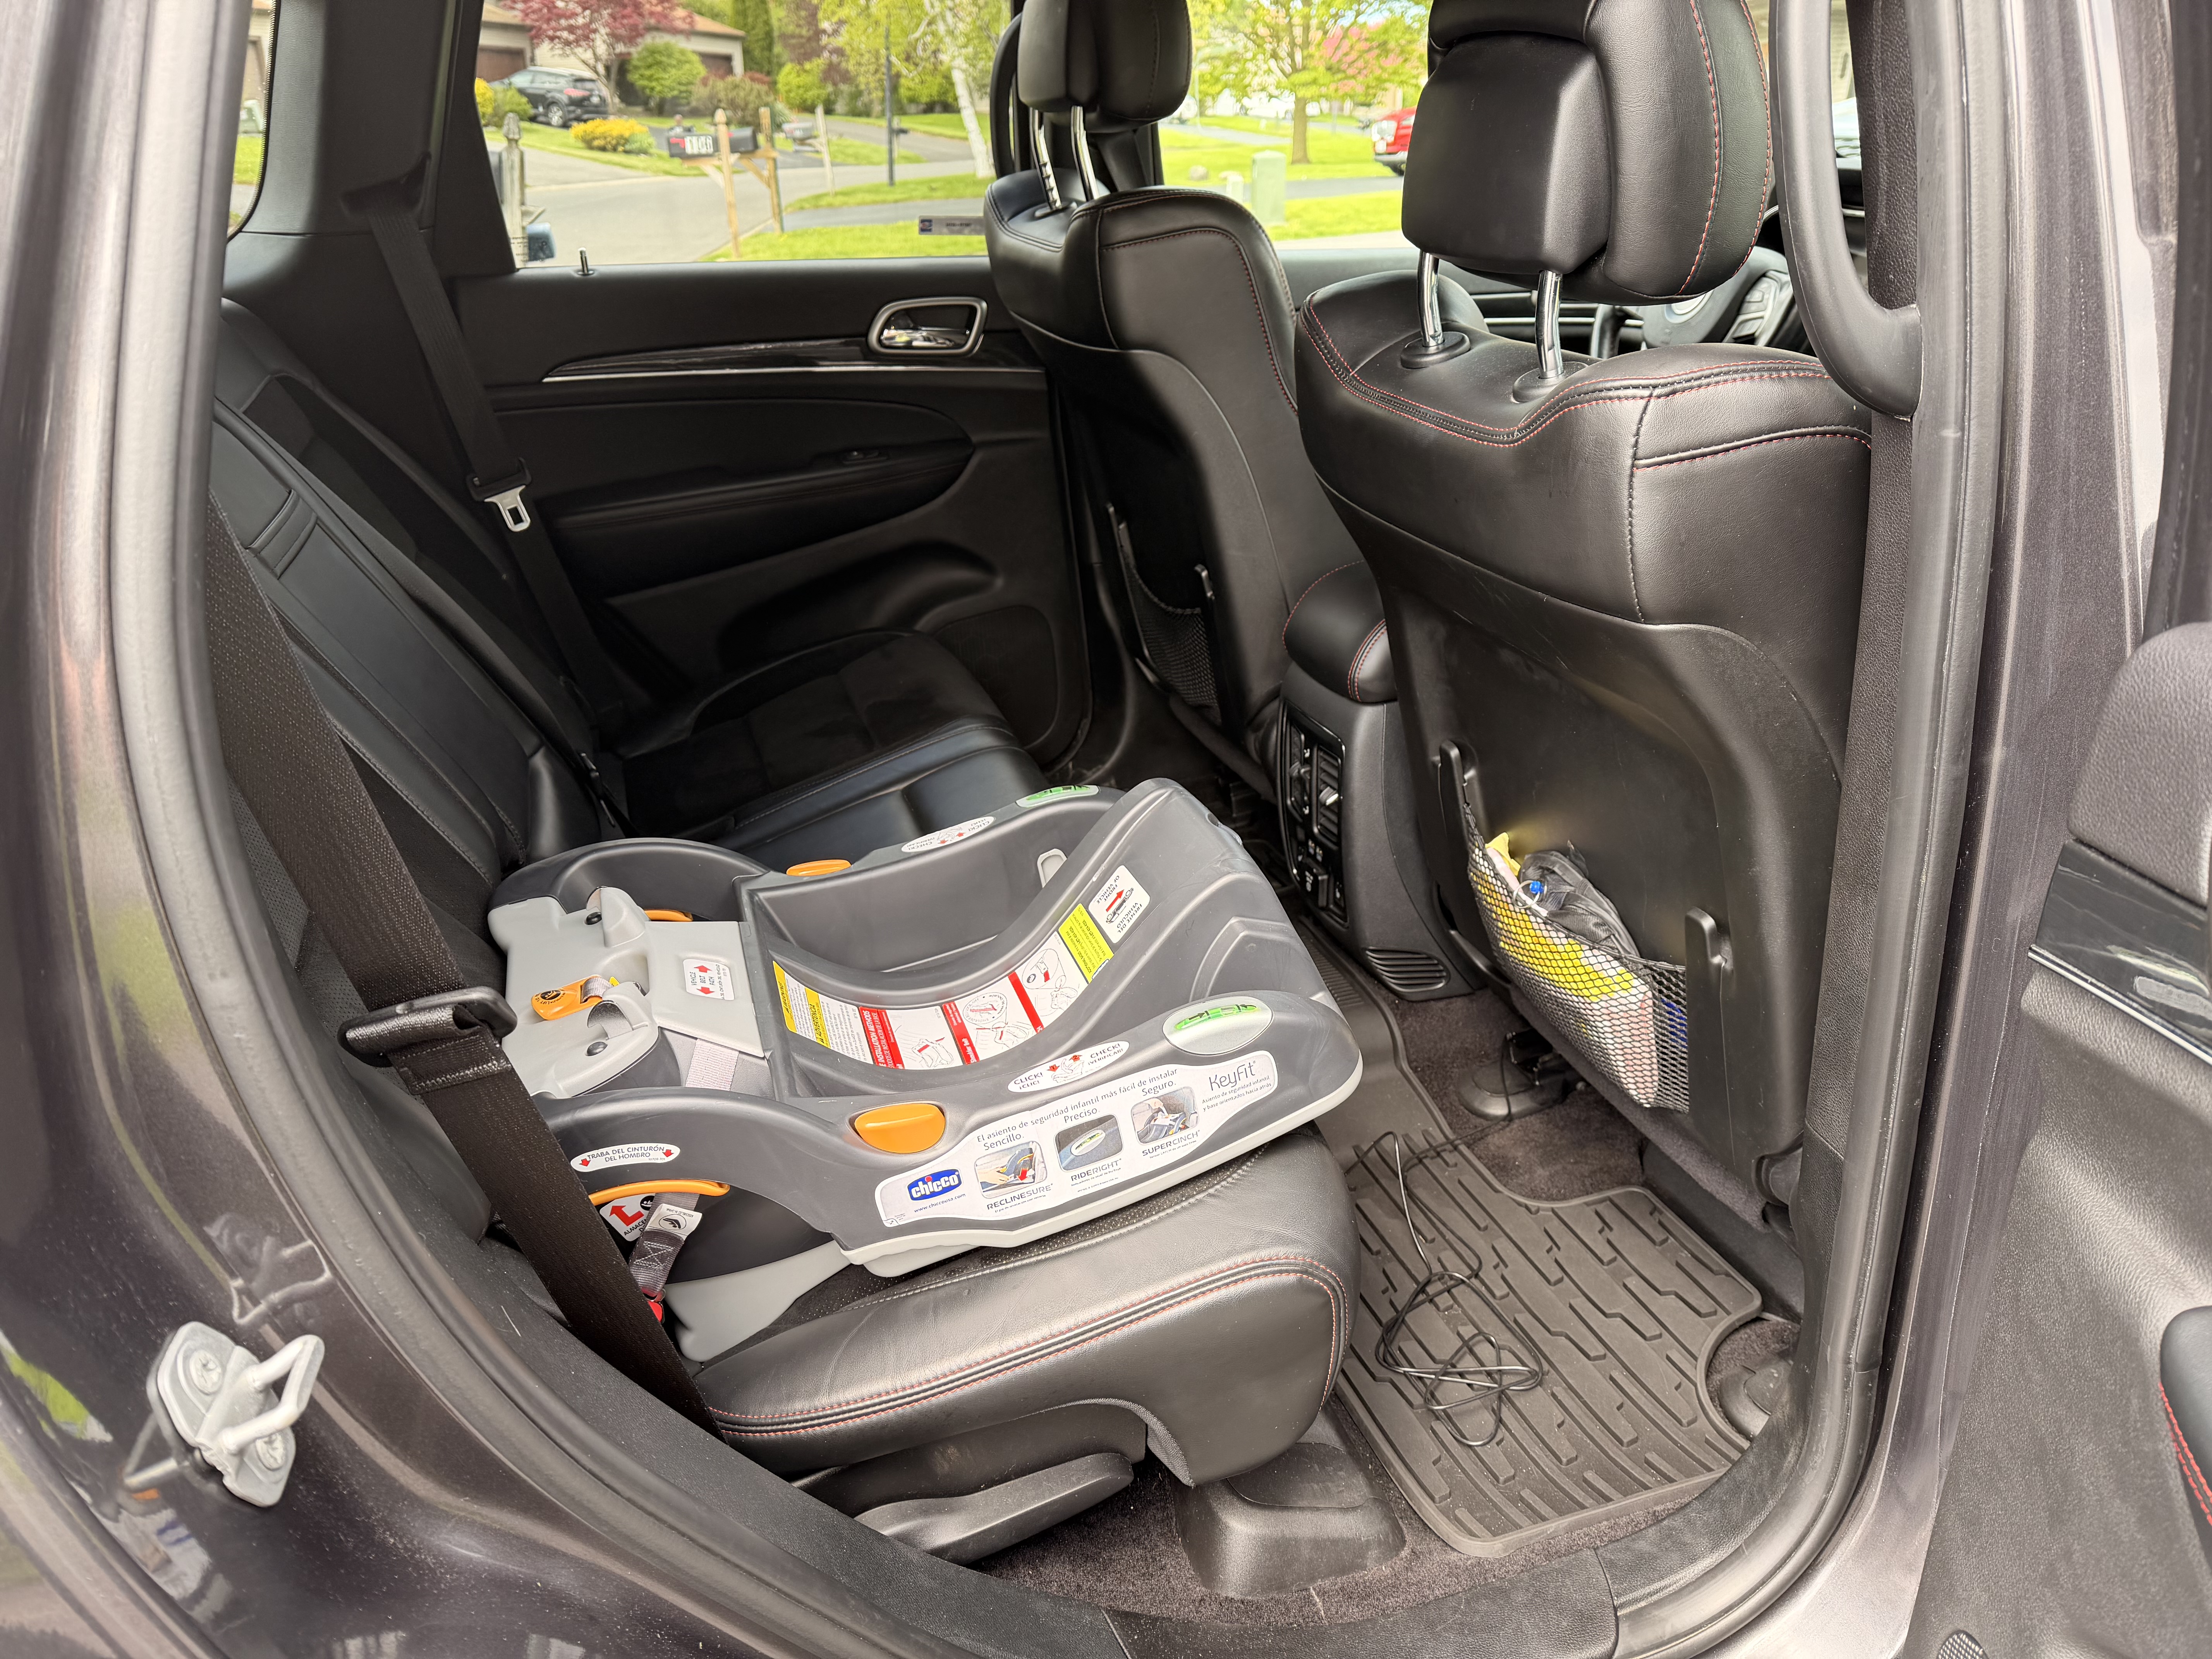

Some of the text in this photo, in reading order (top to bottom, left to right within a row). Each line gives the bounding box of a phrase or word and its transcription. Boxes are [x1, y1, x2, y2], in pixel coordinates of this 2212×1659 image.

[1097, 884, 1113, 904] VEHICLE
[1104, 884, 1118, 902] FRONT
[1118, 904, 1142, 933] FRENTE DEL
[863, 1010, 875, 1031] METHODS
[869, 1032, 885, 1062] INSTALLATION
[1091, 1043, 1121, 1058] CHECK!
[1014, 1072, 1043, 1084] CLICK!
[1142, 1080, 1176, 1096] Seguro.
[1202, 1095, 1220, 1104] Asiento
[1229, 1082, 1251, 1094] seguridad
[1253, 1075, 1270, 1085] infantil
[1220, 1092, 1245, 1104] orientados
[988, 1126, 1016, 1138] asiento
[1031, 1106, 1068, 1125] seguridad
[1071, 1096, 1099, 1110] infantil
[1101, 1091, 1117, 1100] más
[1120, 1083, 1135, 1094] fácil
[1149, 1069, 1177, 1083] instalar
[984, 1133, 1024, 1151] Sencillo.
[587, 1151, 610, 1159] TRABA
[911, 1174, 960, 1198] chicco
[914, 1192, 966, 1213] www.chiccousa.com
